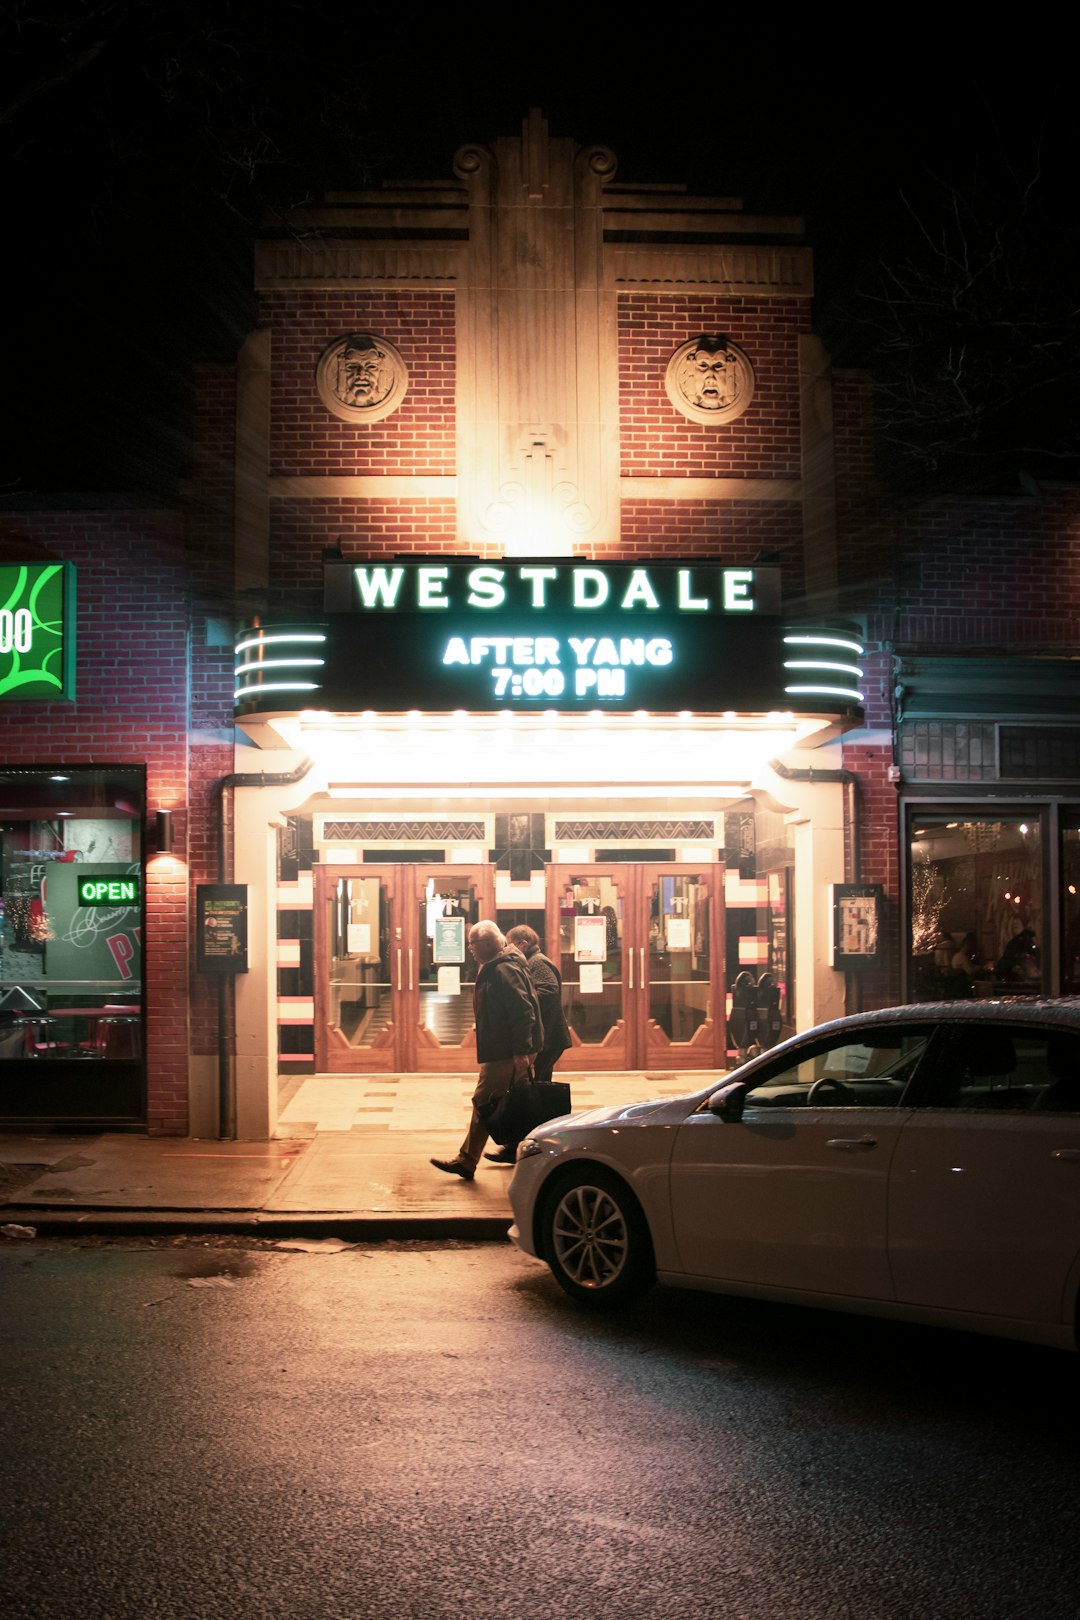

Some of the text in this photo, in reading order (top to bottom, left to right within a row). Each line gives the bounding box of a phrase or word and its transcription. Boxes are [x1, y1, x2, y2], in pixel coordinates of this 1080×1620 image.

[354, 567, 753, 611] WESTDALE
[443, 637, 673, 666] AFTER YANG
[491, 668, 625, 696] 7:00 PM
[82, 883, 135, 900] OPEN
